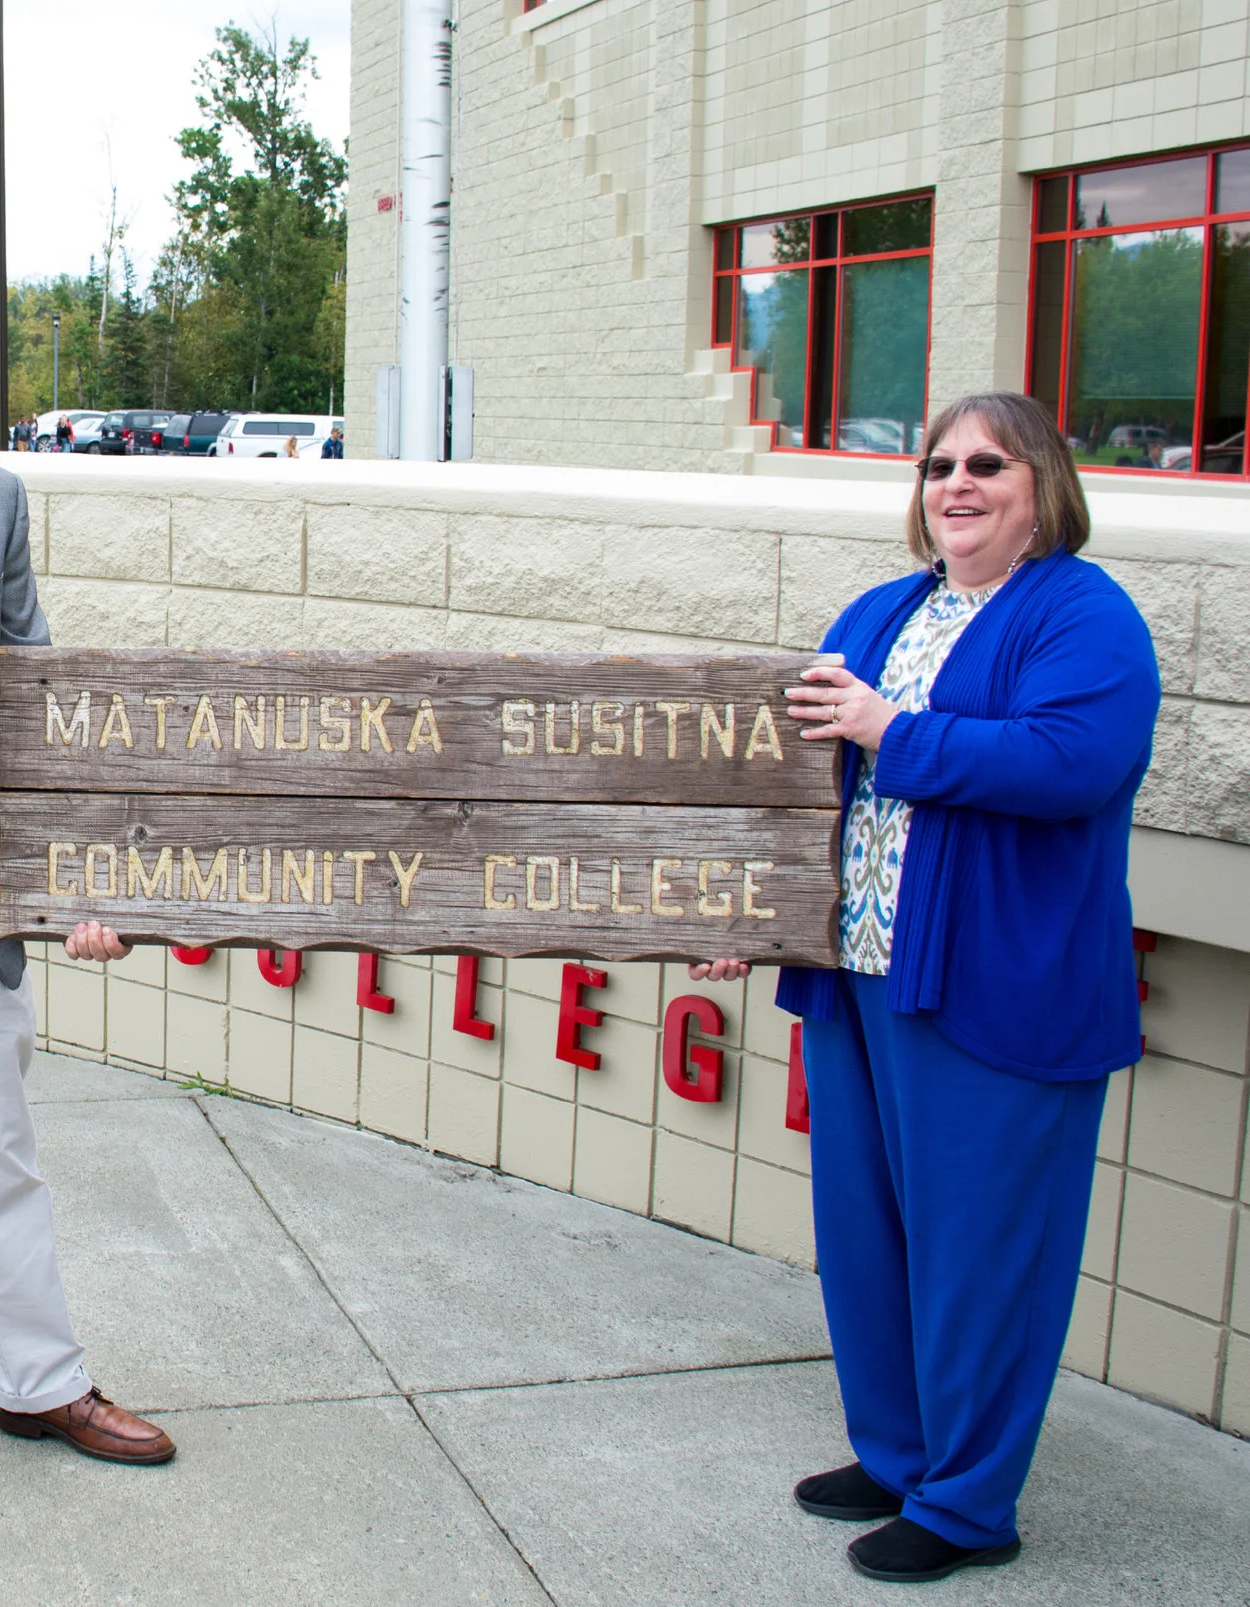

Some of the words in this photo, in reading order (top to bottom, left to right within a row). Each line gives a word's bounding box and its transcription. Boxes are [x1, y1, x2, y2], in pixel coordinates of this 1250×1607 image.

[46, 690, 445, 755] MATANUSKA
[501, 697, 784, 761] SUSITNA
[47, 841, 424, 909] COMMUNITY
[483, 855, 777, 919] COLLEGE
[170, 946, 811, 1136] LLEG
